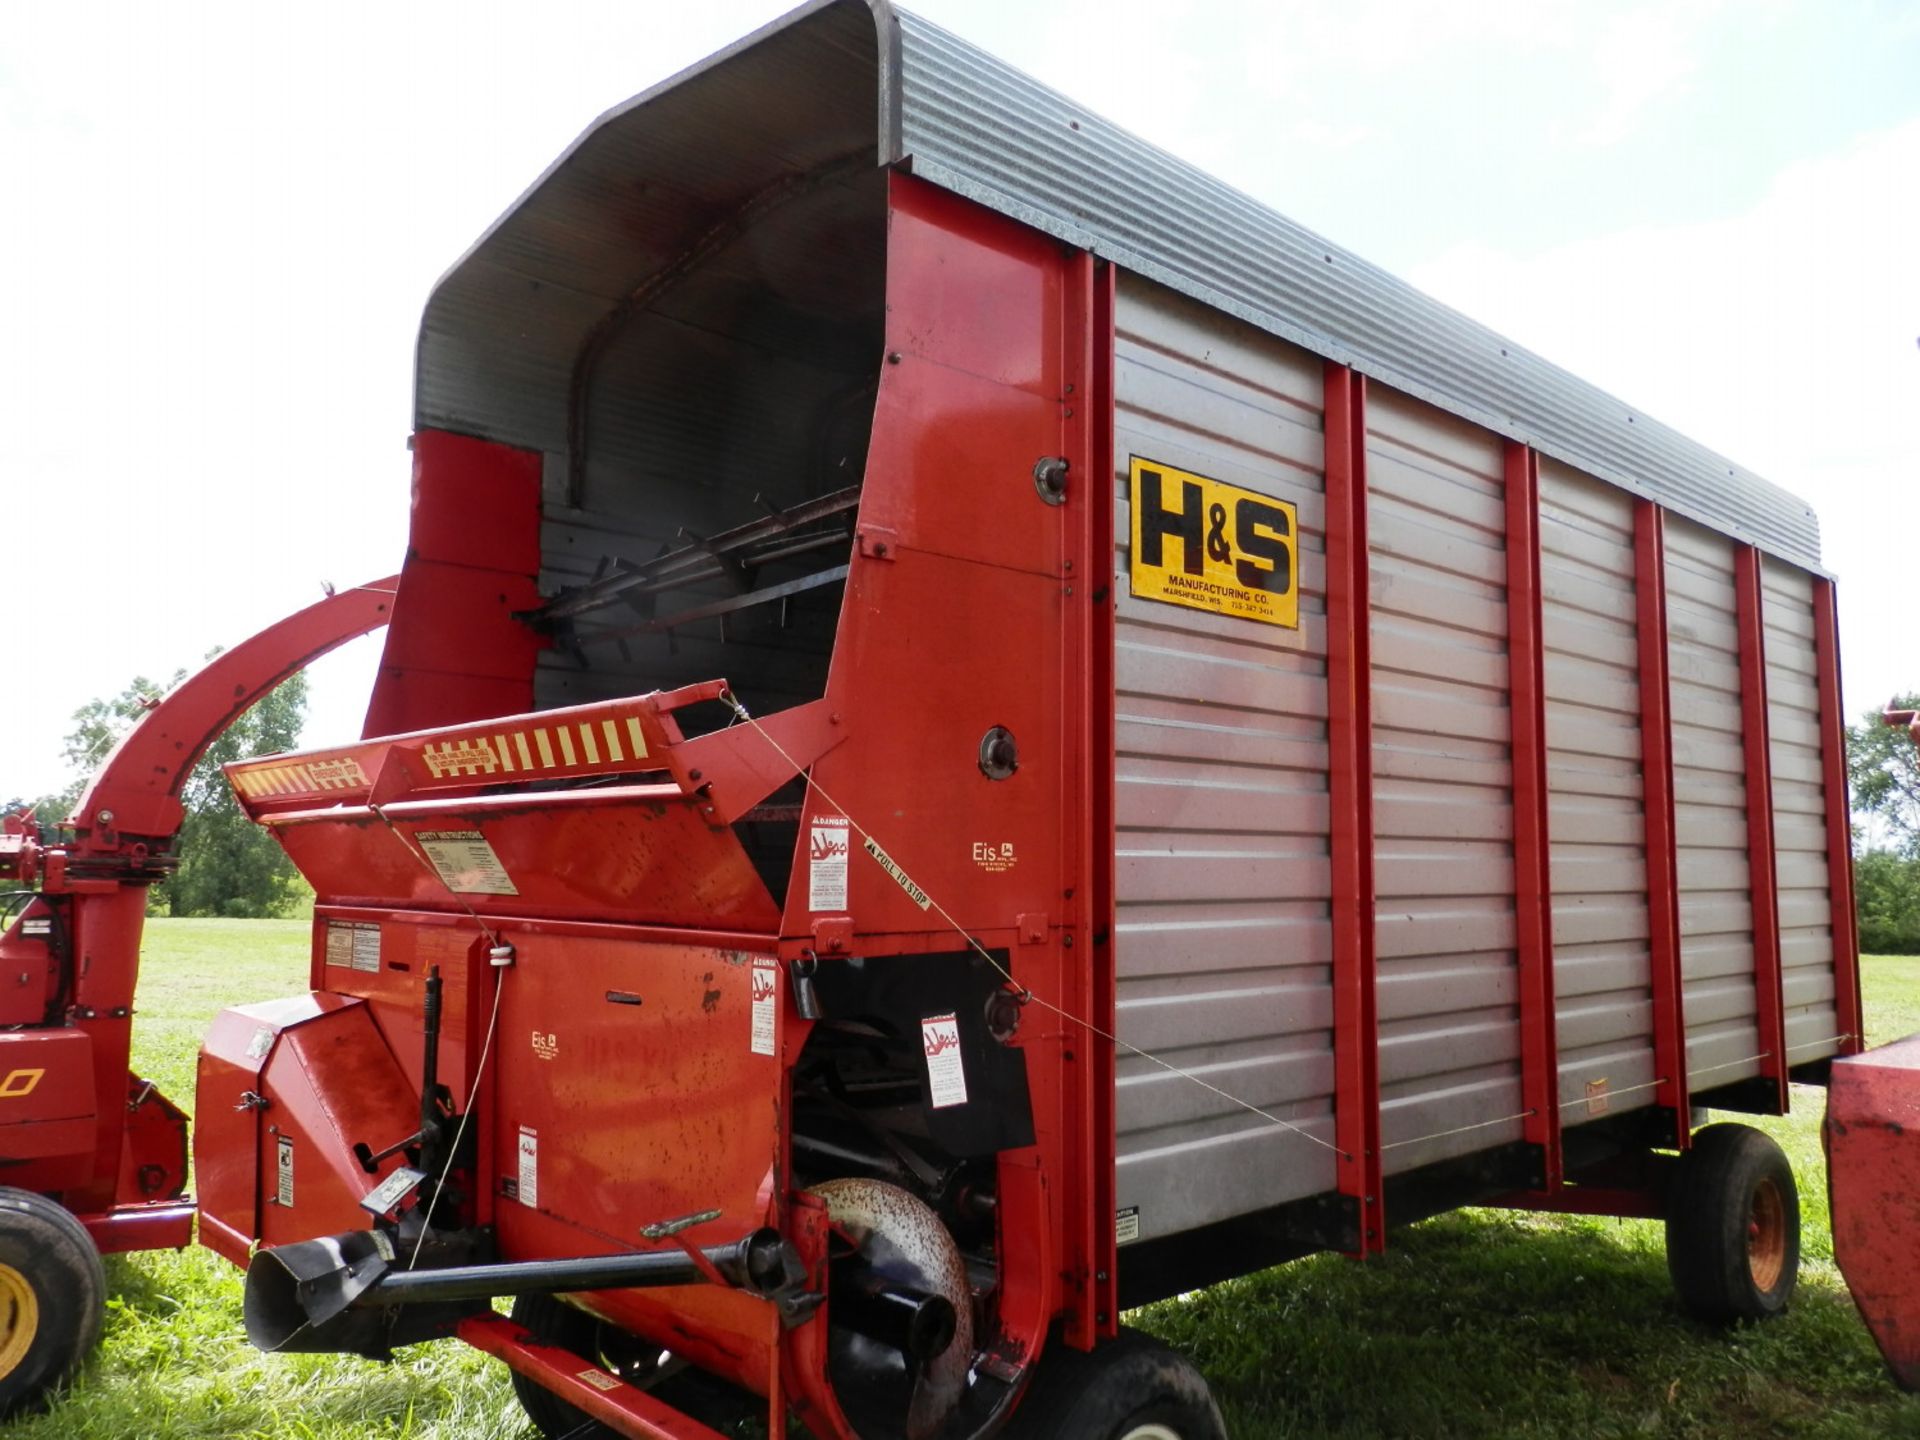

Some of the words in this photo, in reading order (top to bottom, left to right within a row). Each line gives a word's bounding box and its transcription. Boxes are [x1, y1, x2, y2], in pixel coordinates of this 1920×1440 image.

[1140, 468, 1291, 595] H&S
[1168, 574, 1250, 601] MANUFACTURING
[1254, 593, 1269, 605] CO.
[820, 818, 848, 826] DANGER
[973, 842, 997, 861] Eis
[907, 882, 928, 904] STOP
[532, 1031, 546, 1049] Eis
